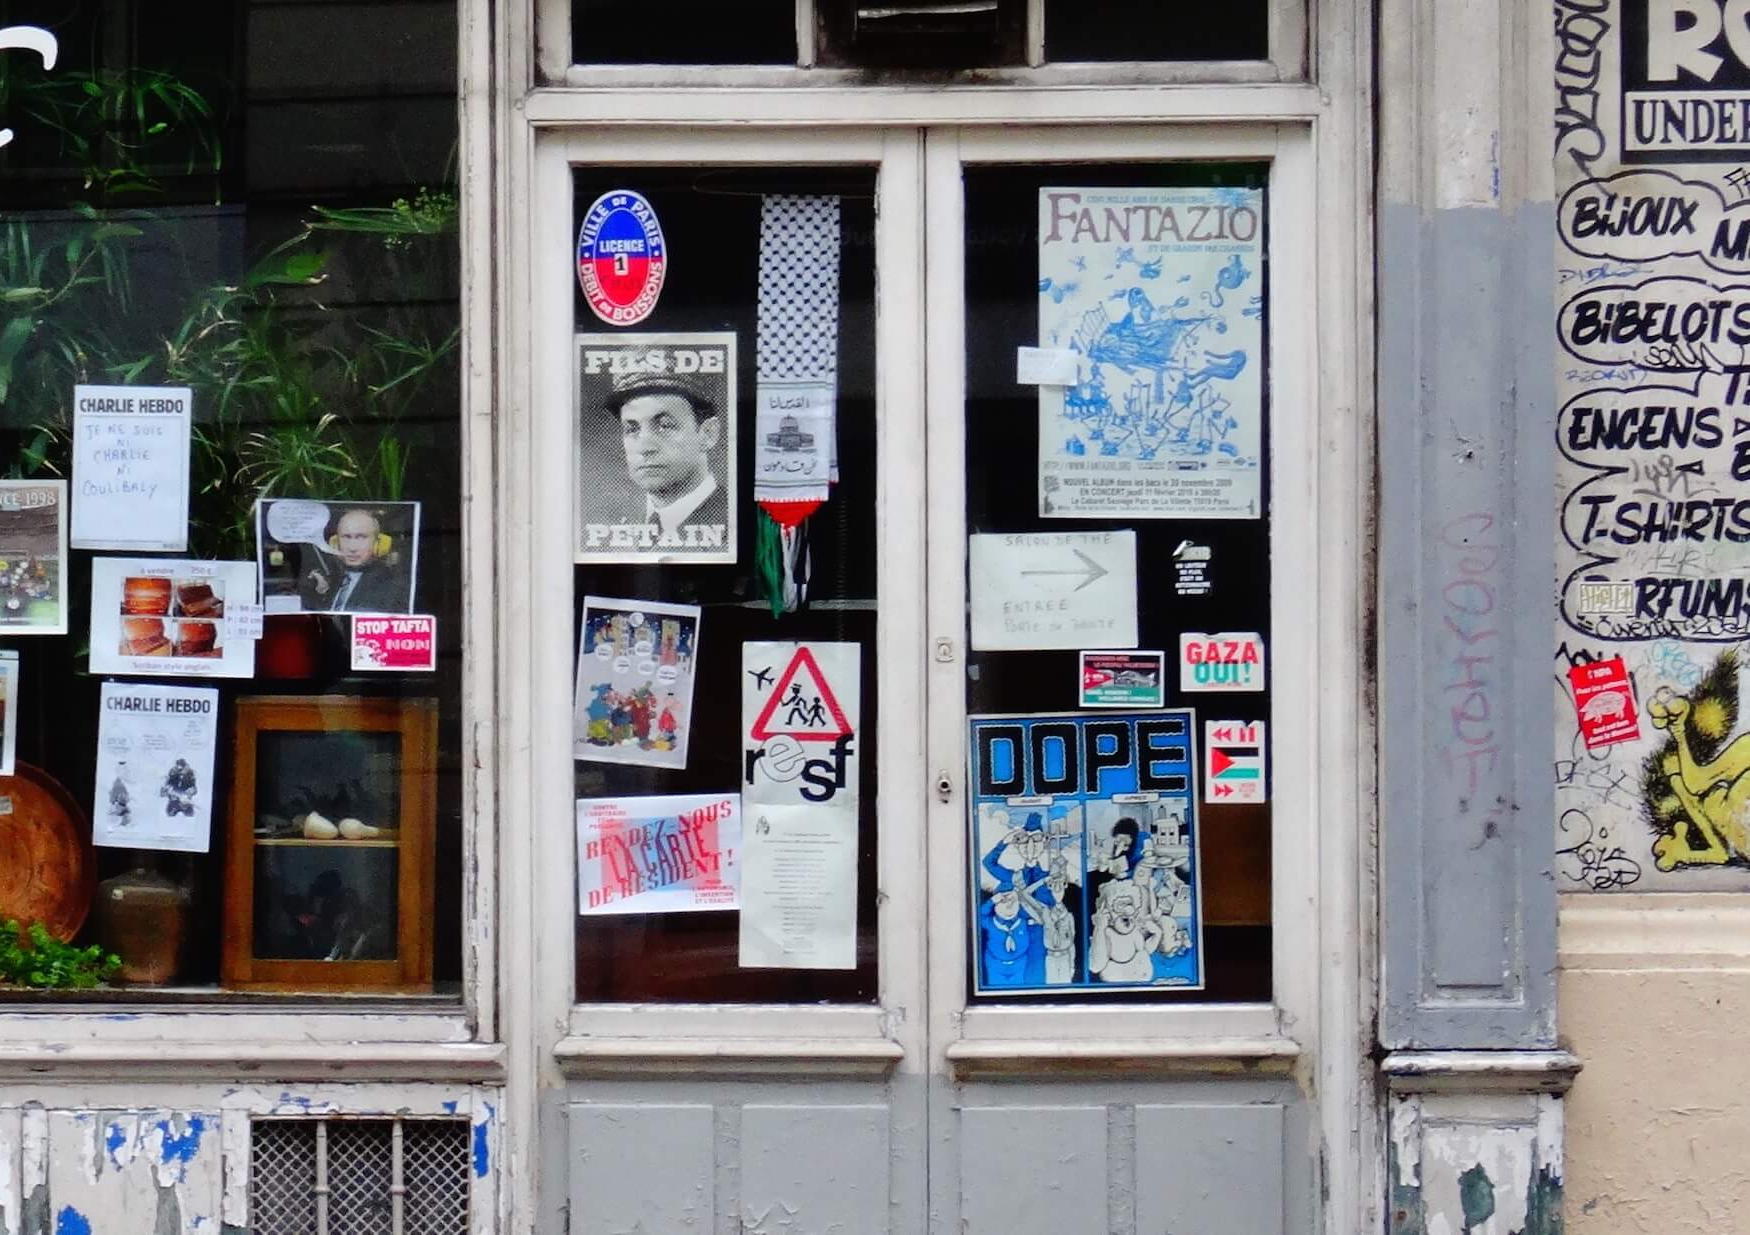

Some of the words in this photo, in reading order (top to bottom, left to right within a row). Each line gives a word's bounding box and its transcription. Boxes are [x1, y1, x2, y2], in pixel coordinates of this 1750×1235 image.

[1632, 99, 1750, 145] UNDE
[582, 204, 609, 247] VILLE
[631, 201, 660, 247] PARIS
[1044, 193, 1258, 244] FANTAZIO
[599, 239, 645, 253] LICENCE
[612, 262, 662, 321] BOISSONS
[584, 350, 666, 374] FILS
[674, 350, 724, 374] DE
[80, 399, 134, 413] CHARLIE
[139, 399, 183, 413] HEBDO
[1568, 407, 1723, 450] ENCENS
[356, 620, 388, 634] STOP
[391, 620, 430, 634] TAFTA
[386, 639, 430, 650] NON
[1186, 641, 1258, 664] GAZA
[106, 696, 161, 712] CHARLIE
[166, 698, 211, 713] HEBDO
[976, 719, 1188, 796] DOPE
[586, 800, 732, 859] RENDEZ-NOUS
[609, 843, 641, 883] LA
[641, 826, 712, 874] CARTE
[588, 886, 613, 908] DE
